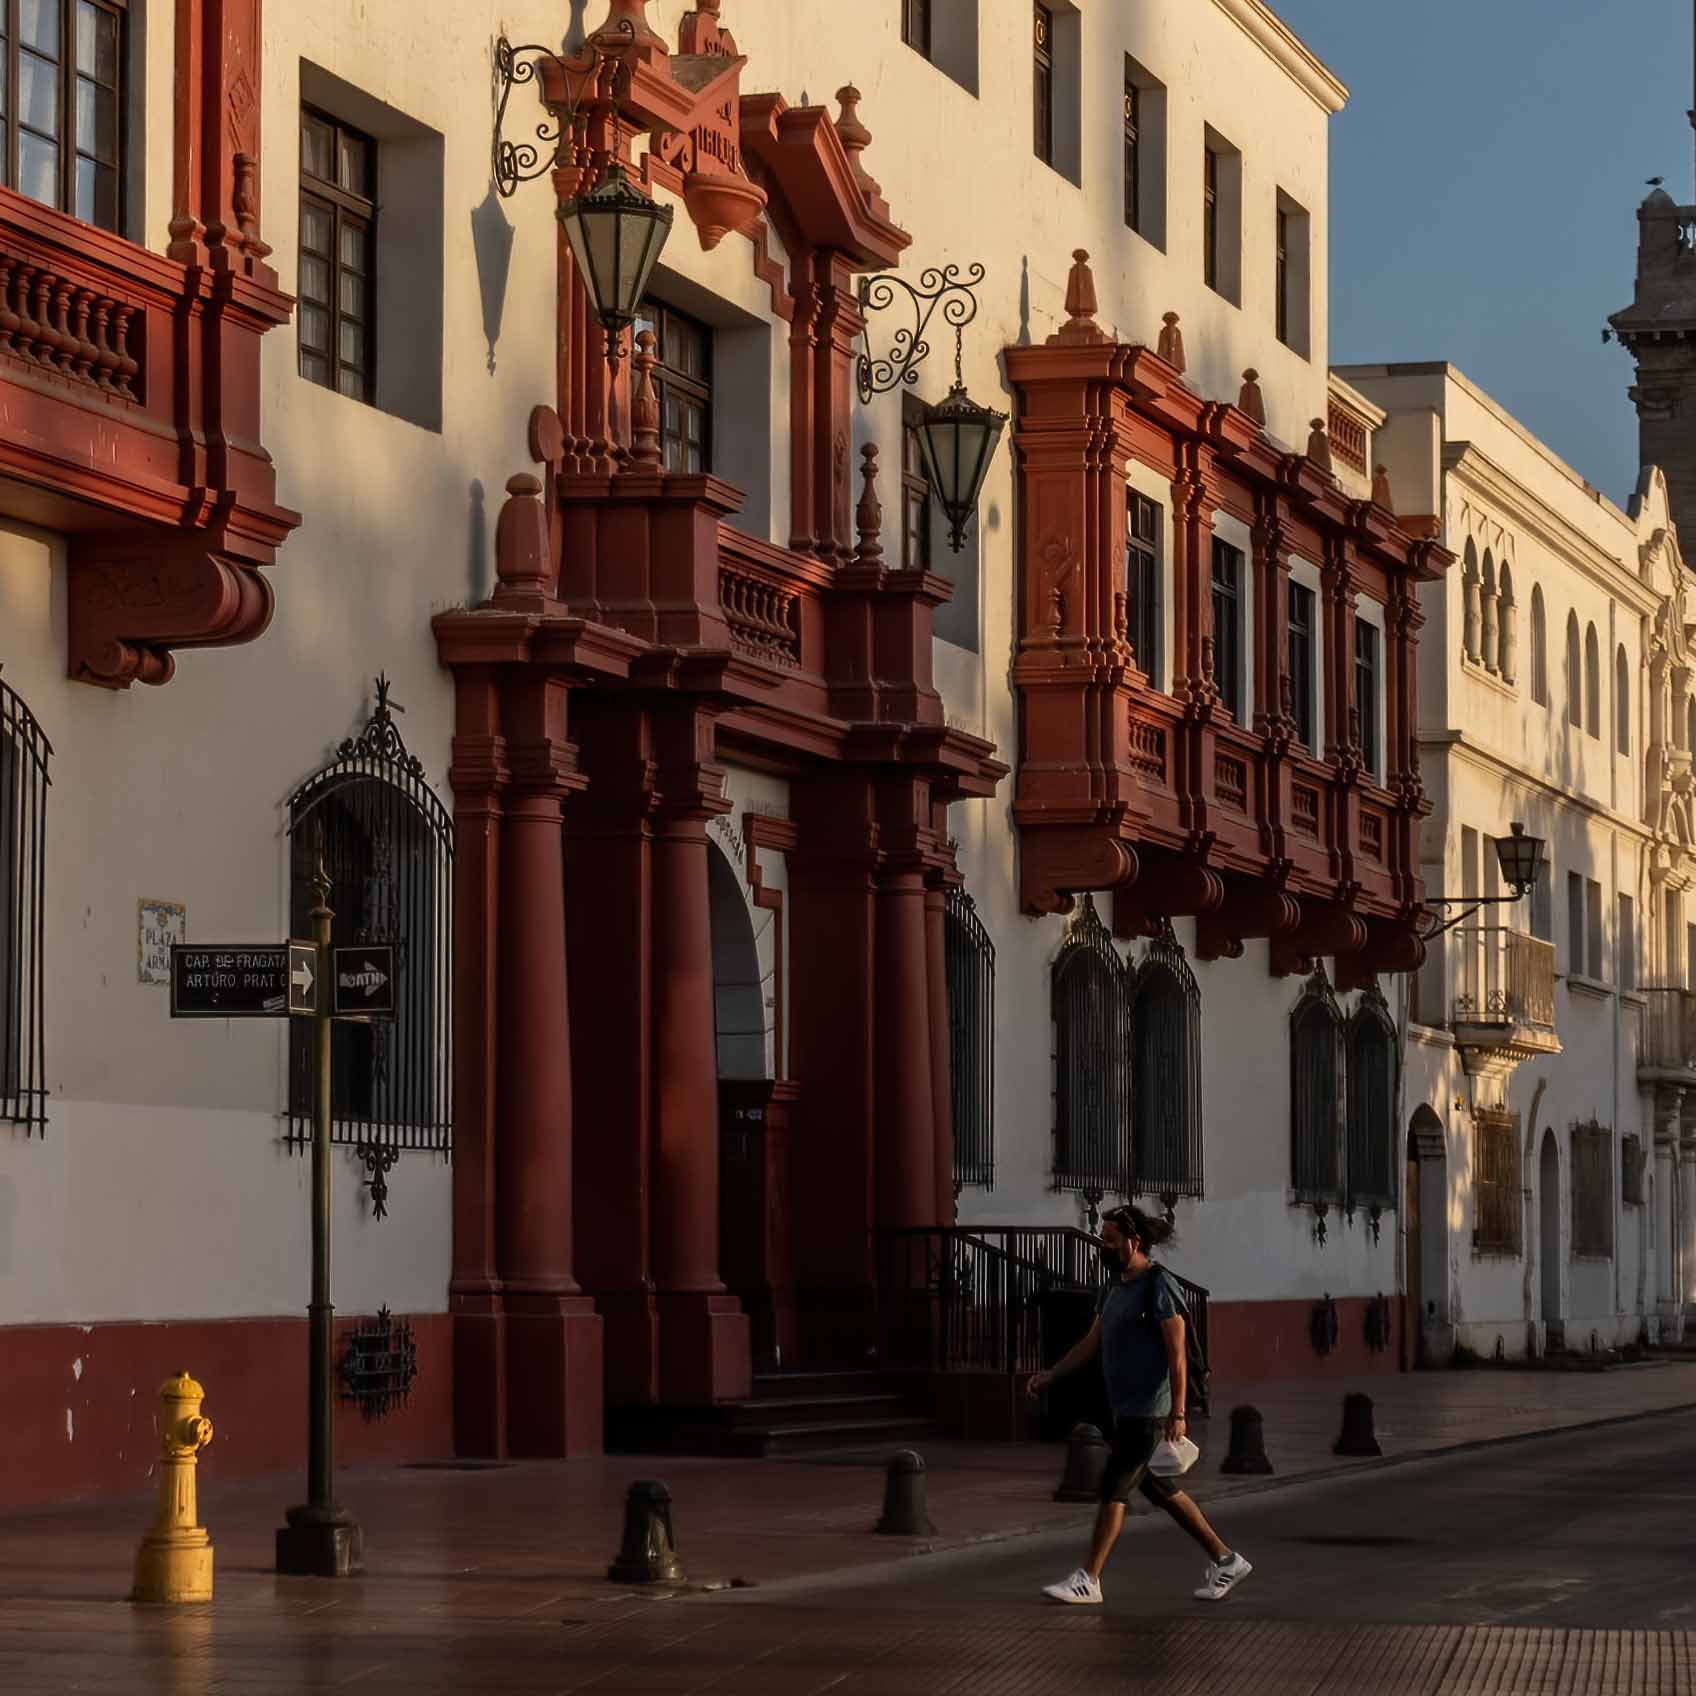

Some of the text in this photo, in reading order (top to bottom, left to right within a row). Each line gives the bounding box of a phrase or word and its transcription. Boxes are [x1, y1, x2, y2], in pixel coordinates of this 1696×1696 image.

[145, 927, 177, 945] PLAZA
[185, 973, 236, 989] ARTURO
[243, 973, 274, 989] PRAT
